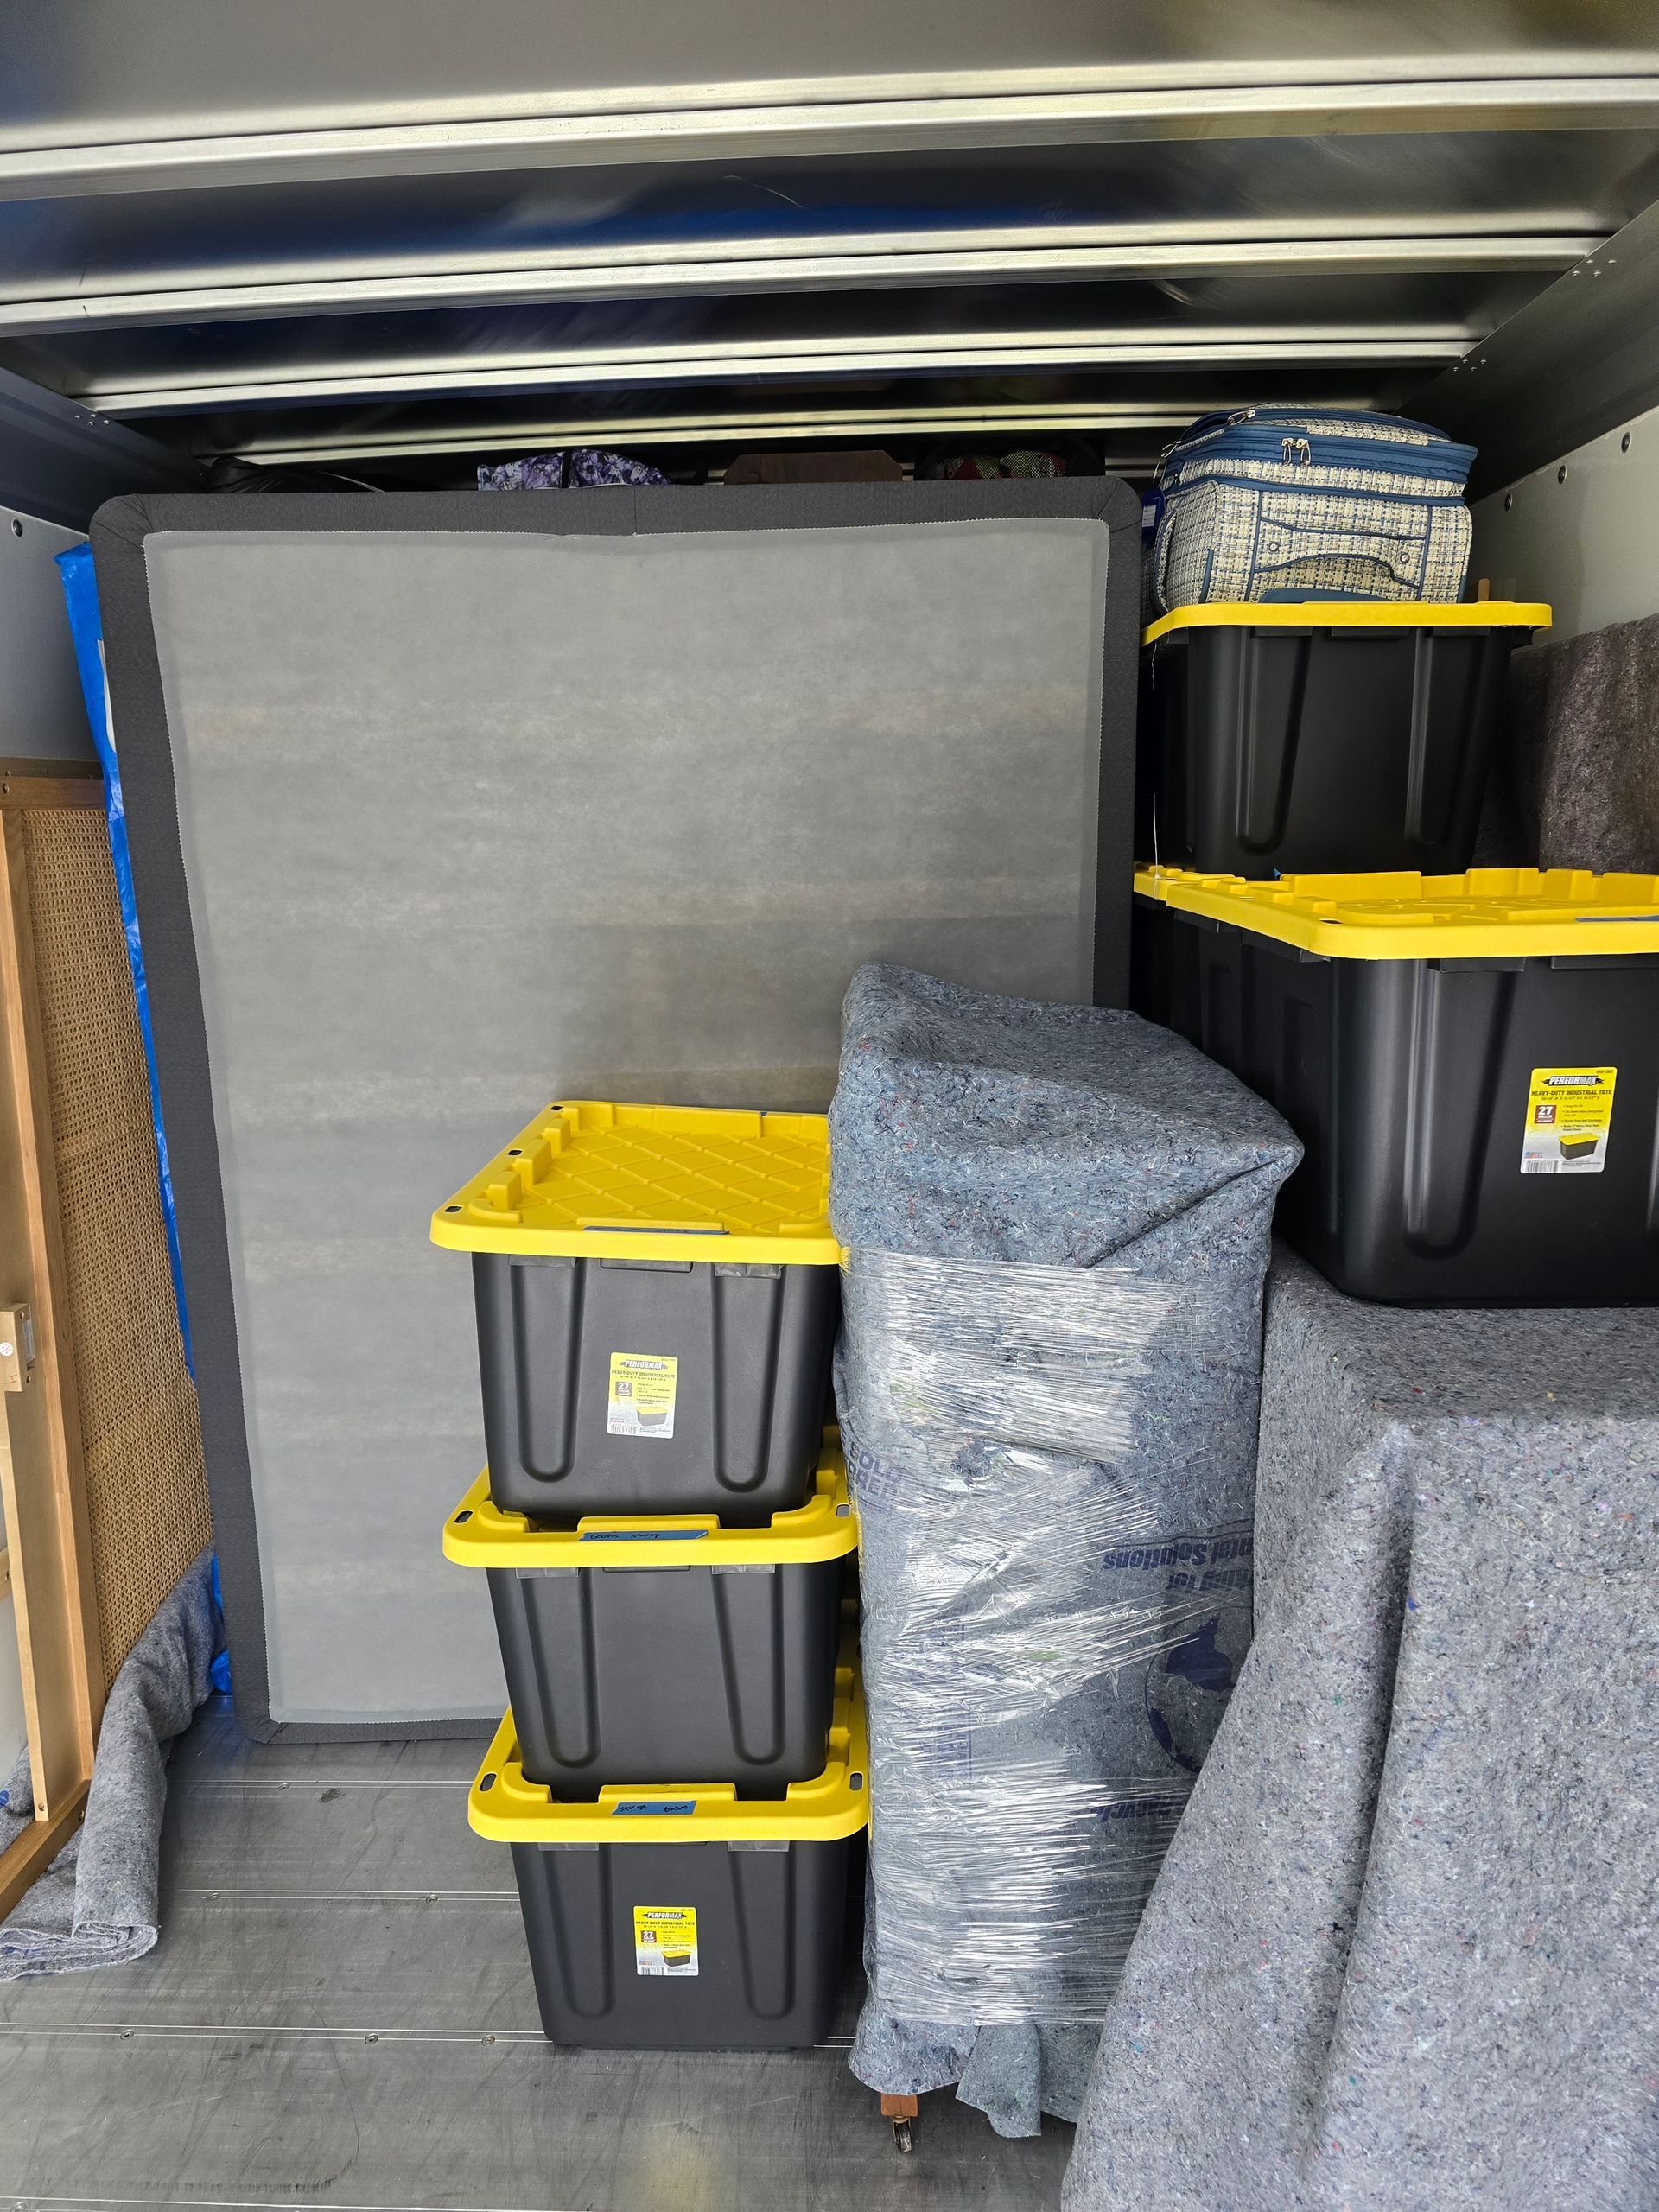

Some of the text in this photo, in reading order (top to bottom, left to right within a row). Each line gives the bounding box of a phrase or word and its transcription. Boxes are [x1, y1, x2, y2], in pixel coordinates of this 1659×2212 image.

[1548, 1076, 1598, 1086] PERFORMAX
[1538, 1106, 1553, 1116] 27
[624, 1360, 663, 1370] PERFORMAX
[1101, 1542, 1208, 1571] Solutions
